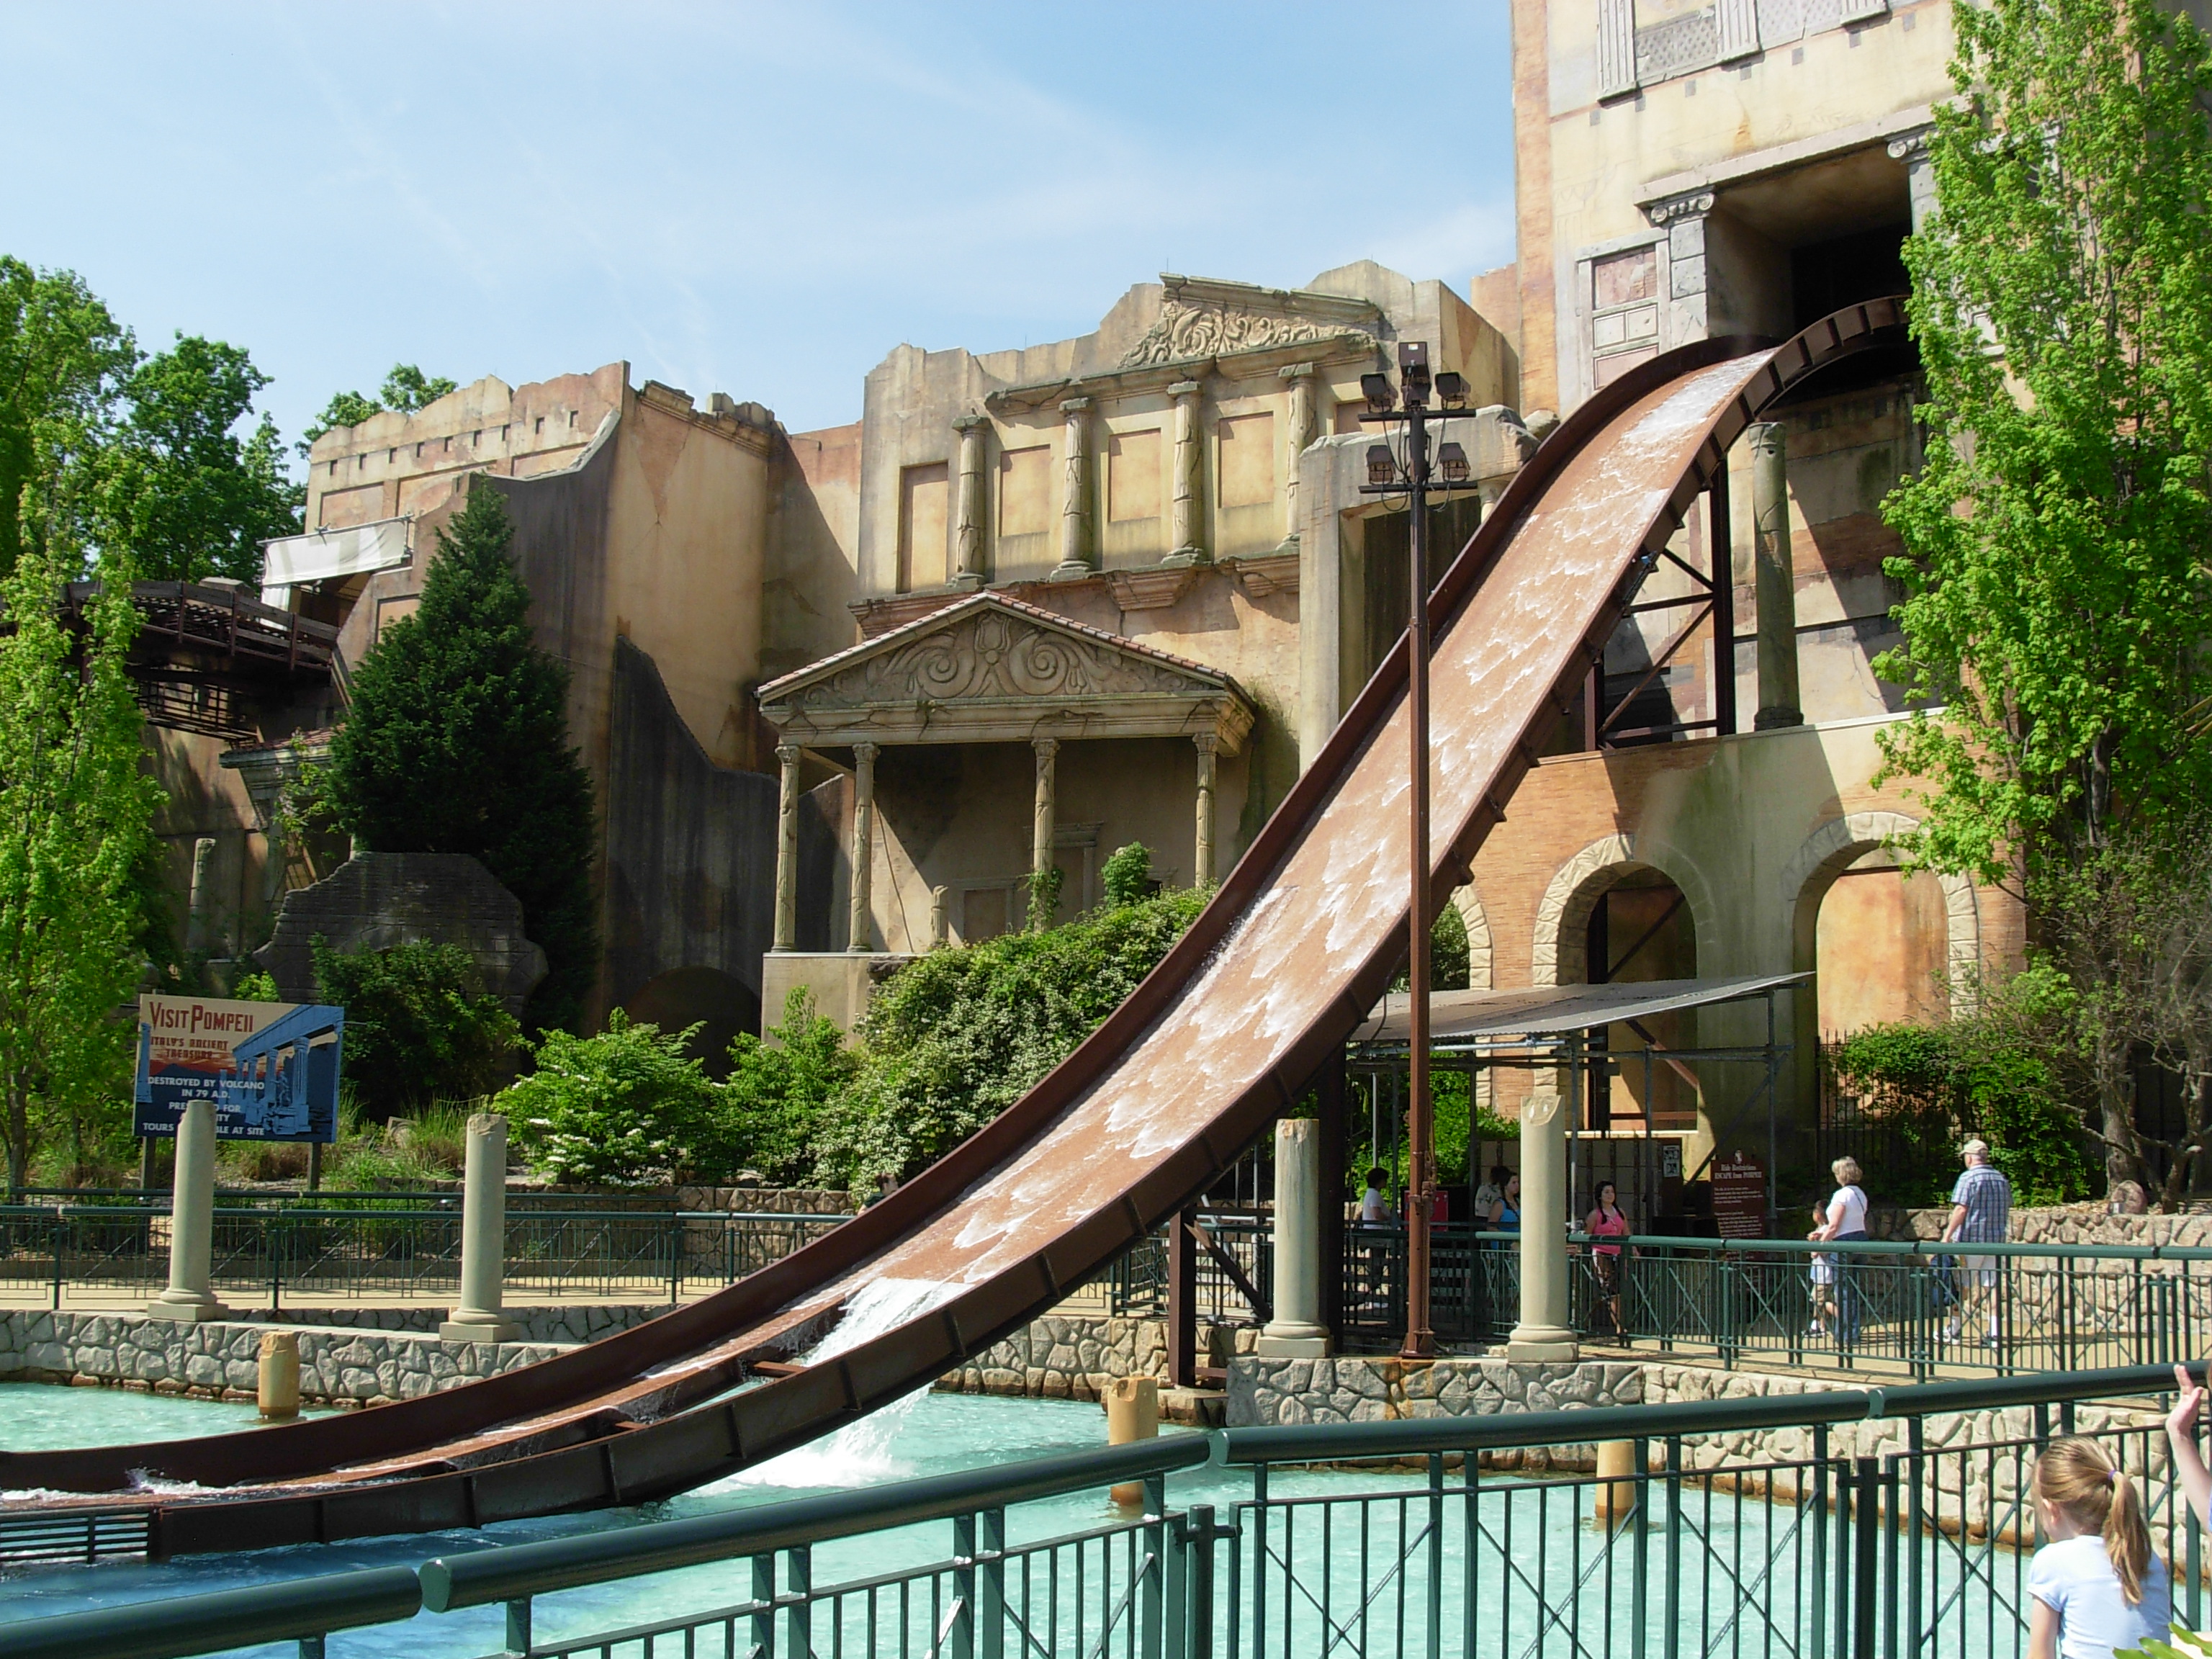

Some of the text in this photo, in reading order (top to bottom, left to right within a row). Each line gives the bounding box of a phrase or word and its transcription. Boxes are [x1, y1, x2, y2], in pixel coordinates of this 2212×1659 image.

[149, 1002, 253, 1033] VISIT POMPEII
[189, 1038, 229, 1051] ANCIENT
[166, 1048, 213, 1059] TREASURE
[148, 1076, 200, 1087] DESTROYED
[219, 1080, 265, 1090] VOLCANO
[211, 1090, 231, 1099] A.D.
[143, 1123, 174, 1132] TOURS
[247, 1127, 265, 1136] SITE
